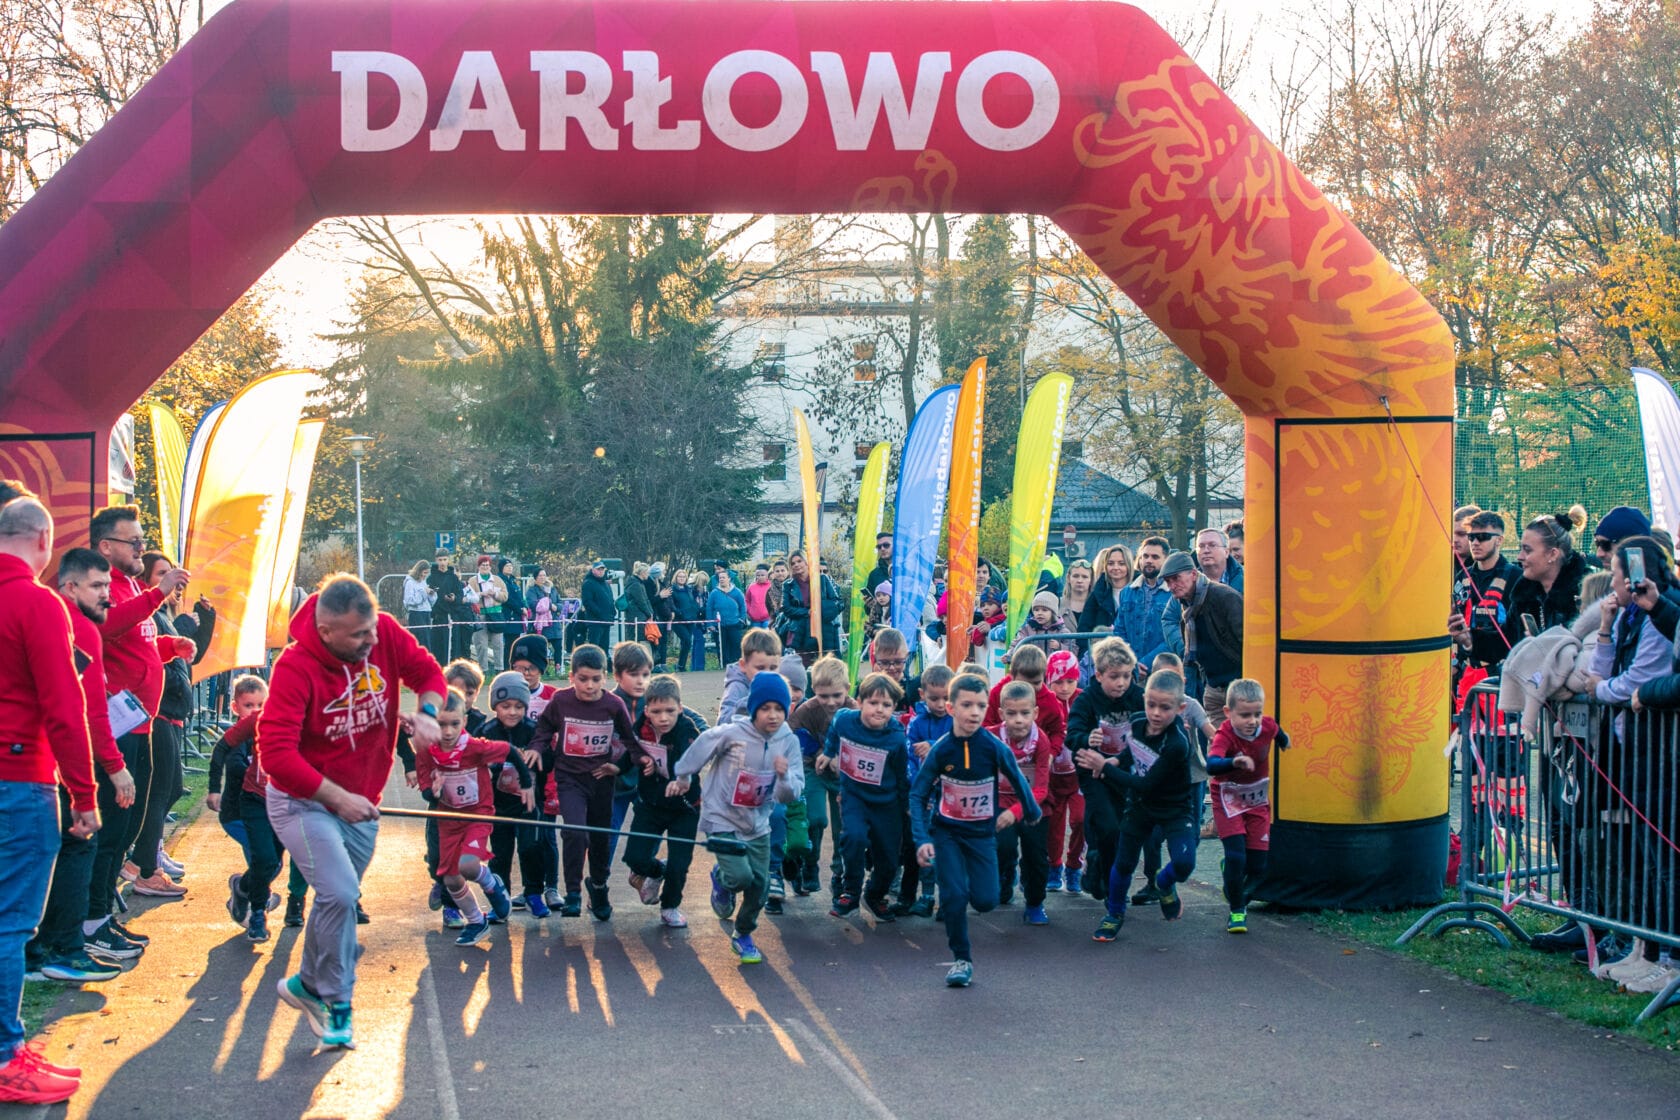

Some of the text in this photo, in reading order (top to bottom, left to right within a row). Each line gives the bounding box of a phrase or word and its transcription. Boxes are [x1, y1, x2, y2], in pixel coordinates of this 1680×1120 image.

[331, 49, 1060, 152] DARŁOWO
[439, 533, 449, 547] P
[583, 735, 608, 745] 162
[857, 759, 875, 772] 55
[457, 785, 465, 796] 8
[1239, 790, 1263, 801] 111
[960, 795, 988, 807] 172
